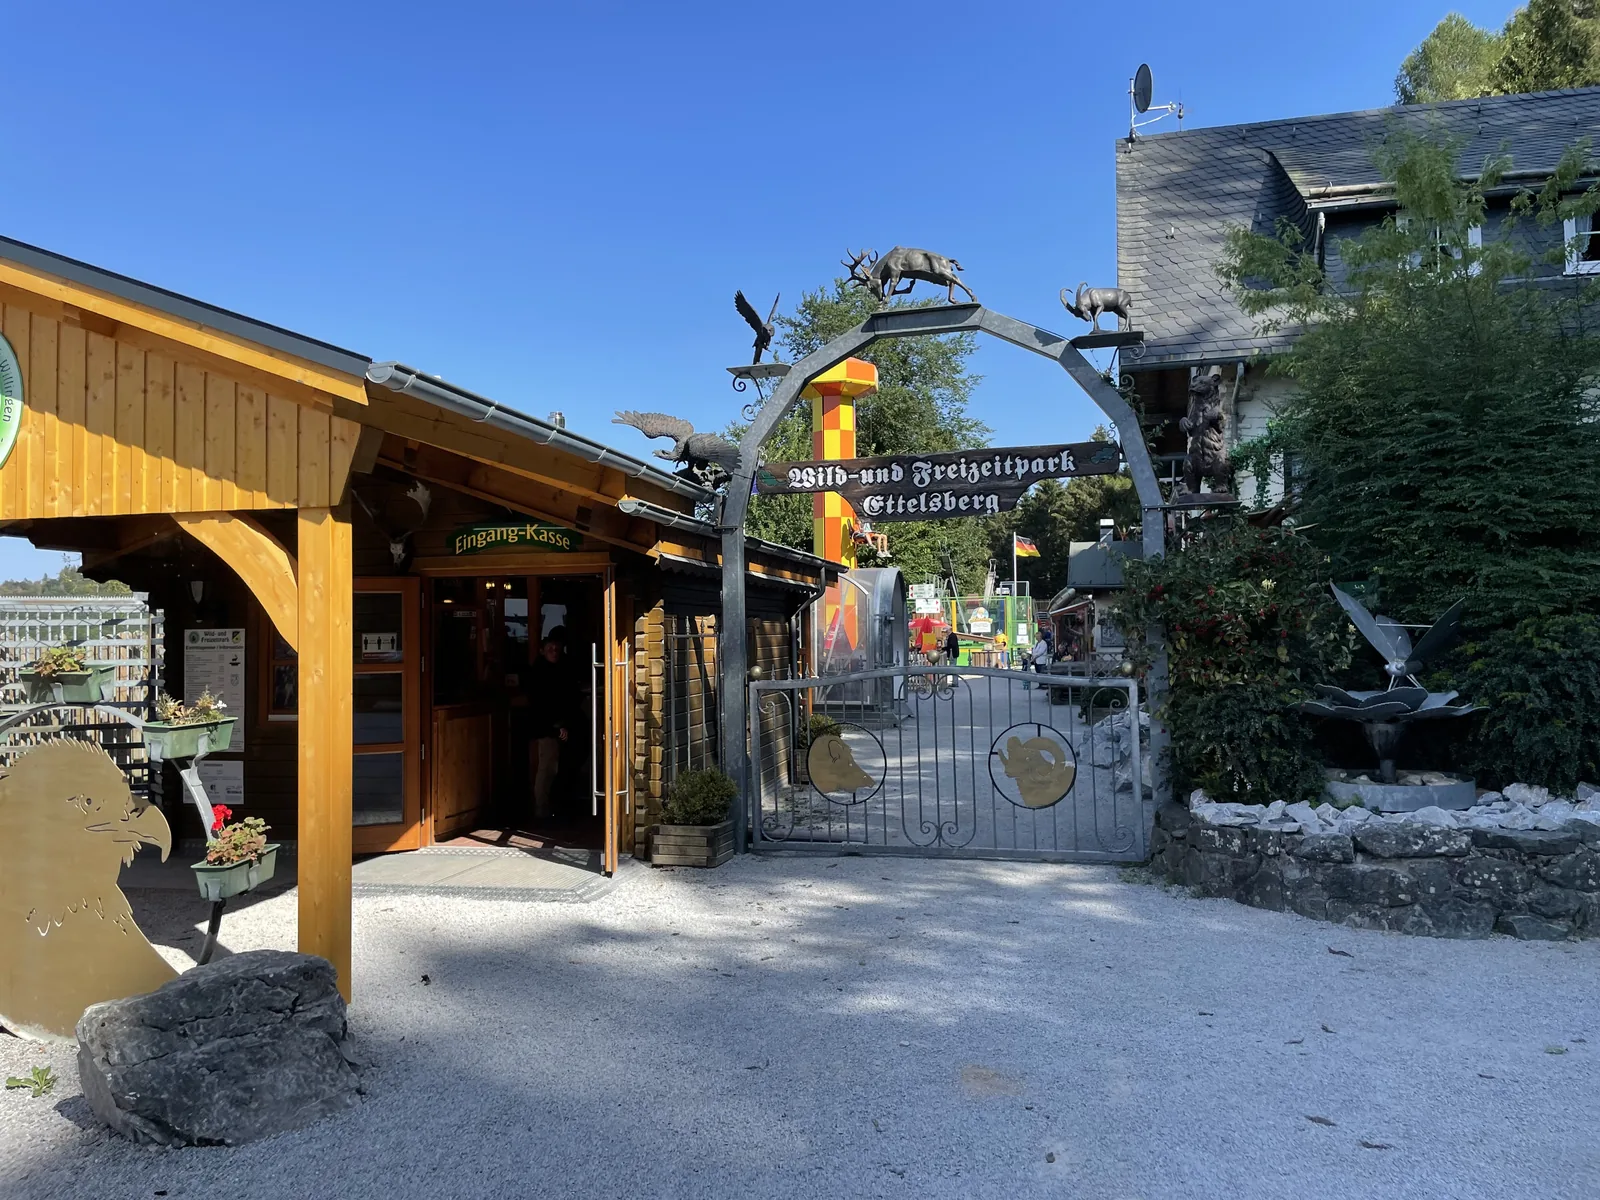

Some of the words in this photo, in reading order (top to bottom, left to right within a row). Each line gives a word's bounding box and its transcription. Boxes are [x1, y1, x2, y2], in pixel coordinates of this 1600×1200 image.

[0, 358, 14, 423] Willingen
[912, 450, 1077, 488] Freizeitpark
[862, 491, 1000, 516] Ettelsberg
[456, 524, 570, 555] Eingang-Kasse
